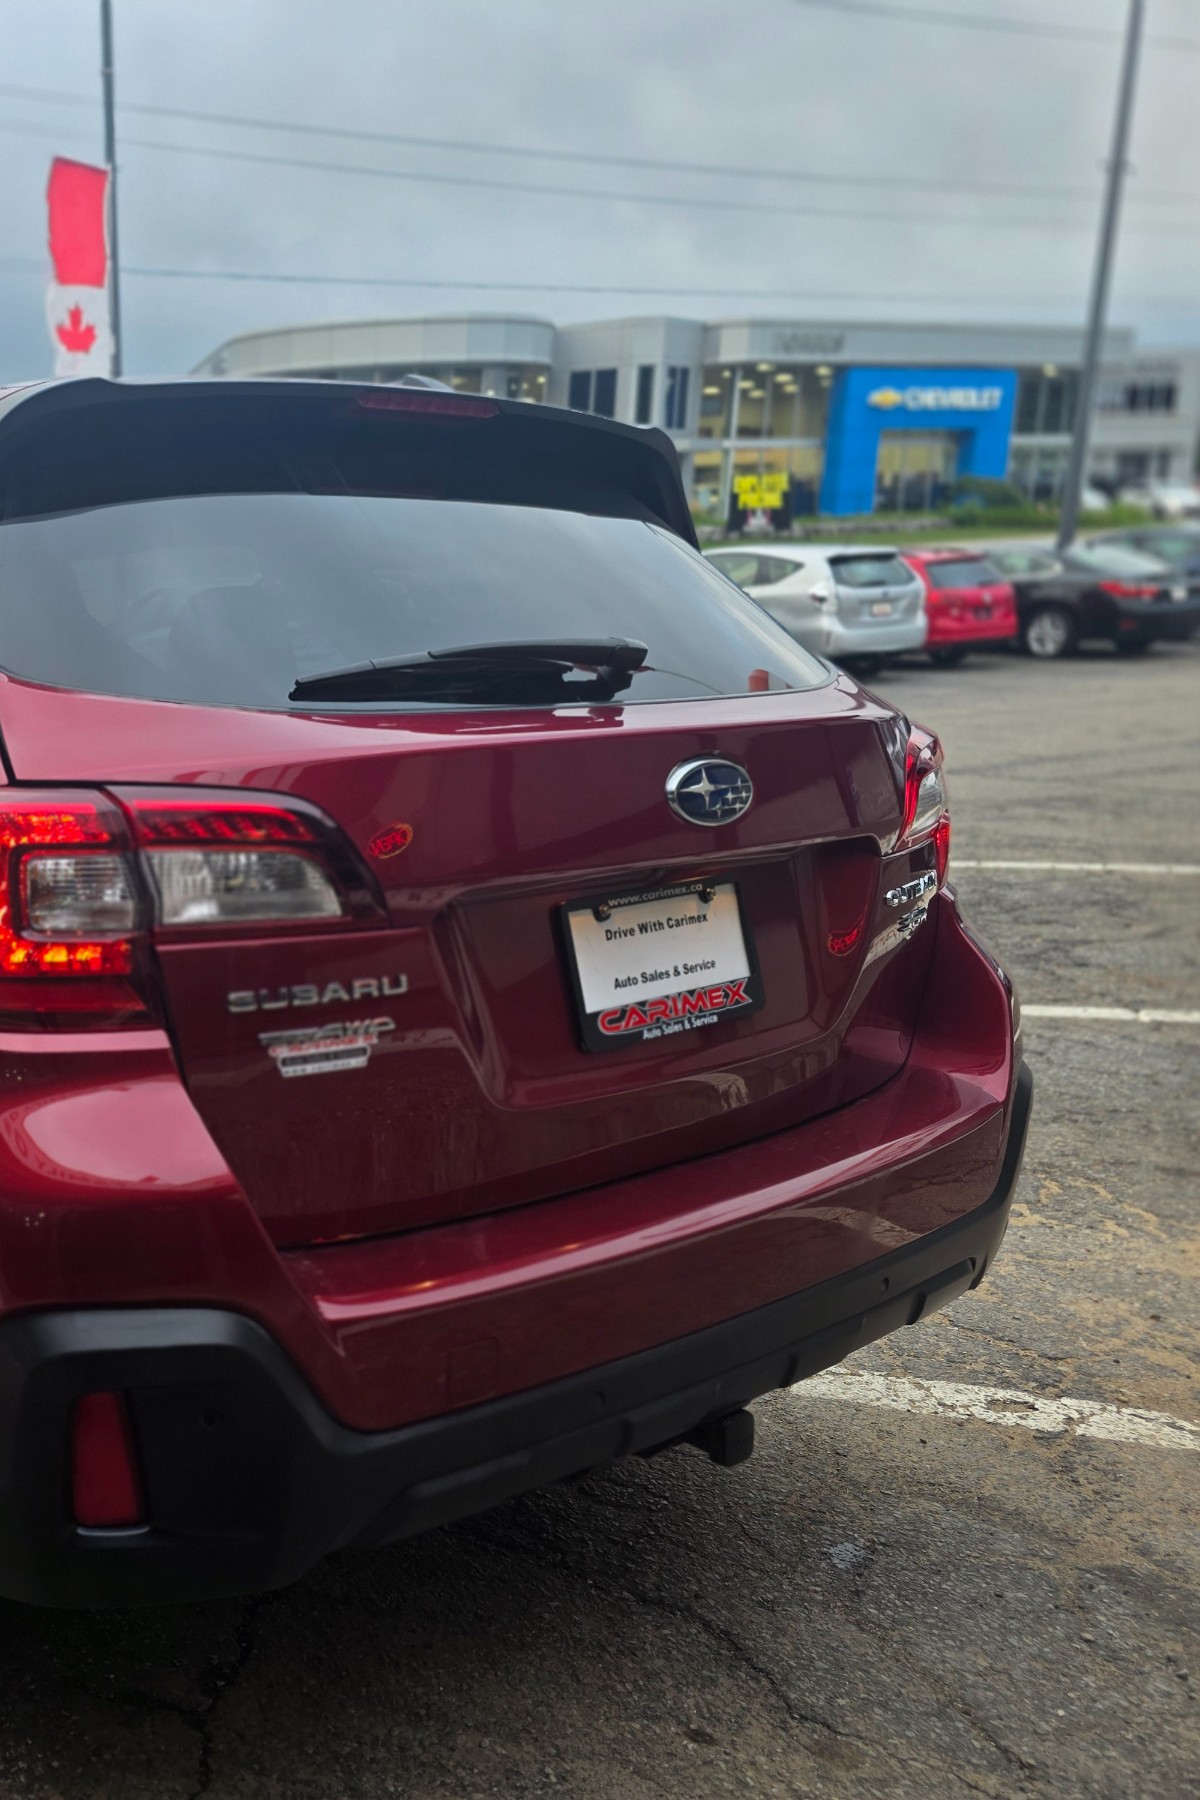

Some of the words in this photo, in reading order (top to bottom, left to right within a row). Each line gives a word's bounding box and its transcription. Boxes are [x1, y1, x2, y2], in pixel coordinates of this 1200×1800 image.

[608, 883, 703, 907] www.carimex.ca
[605, 926, 635, 941] Drive
[638, 919, 665, 935] With
[667, 914, 708, 928] Carimex
[614, 974, 638, 990] Auto
[641, 967, 670, 983] Sales
[673, 965, 681, 976] &
[683, 959, 716, 974] Service
[227, 974, 408, 1013] SUBARU
[599, 979, 750, 1034] CARIMEX
[643, 1024, 660, 1040] Auto
[662, 1020, 683, 1035] Sales
[684, 1017, 691, 1030] &
[693, 1014, 718, 1028] Service
